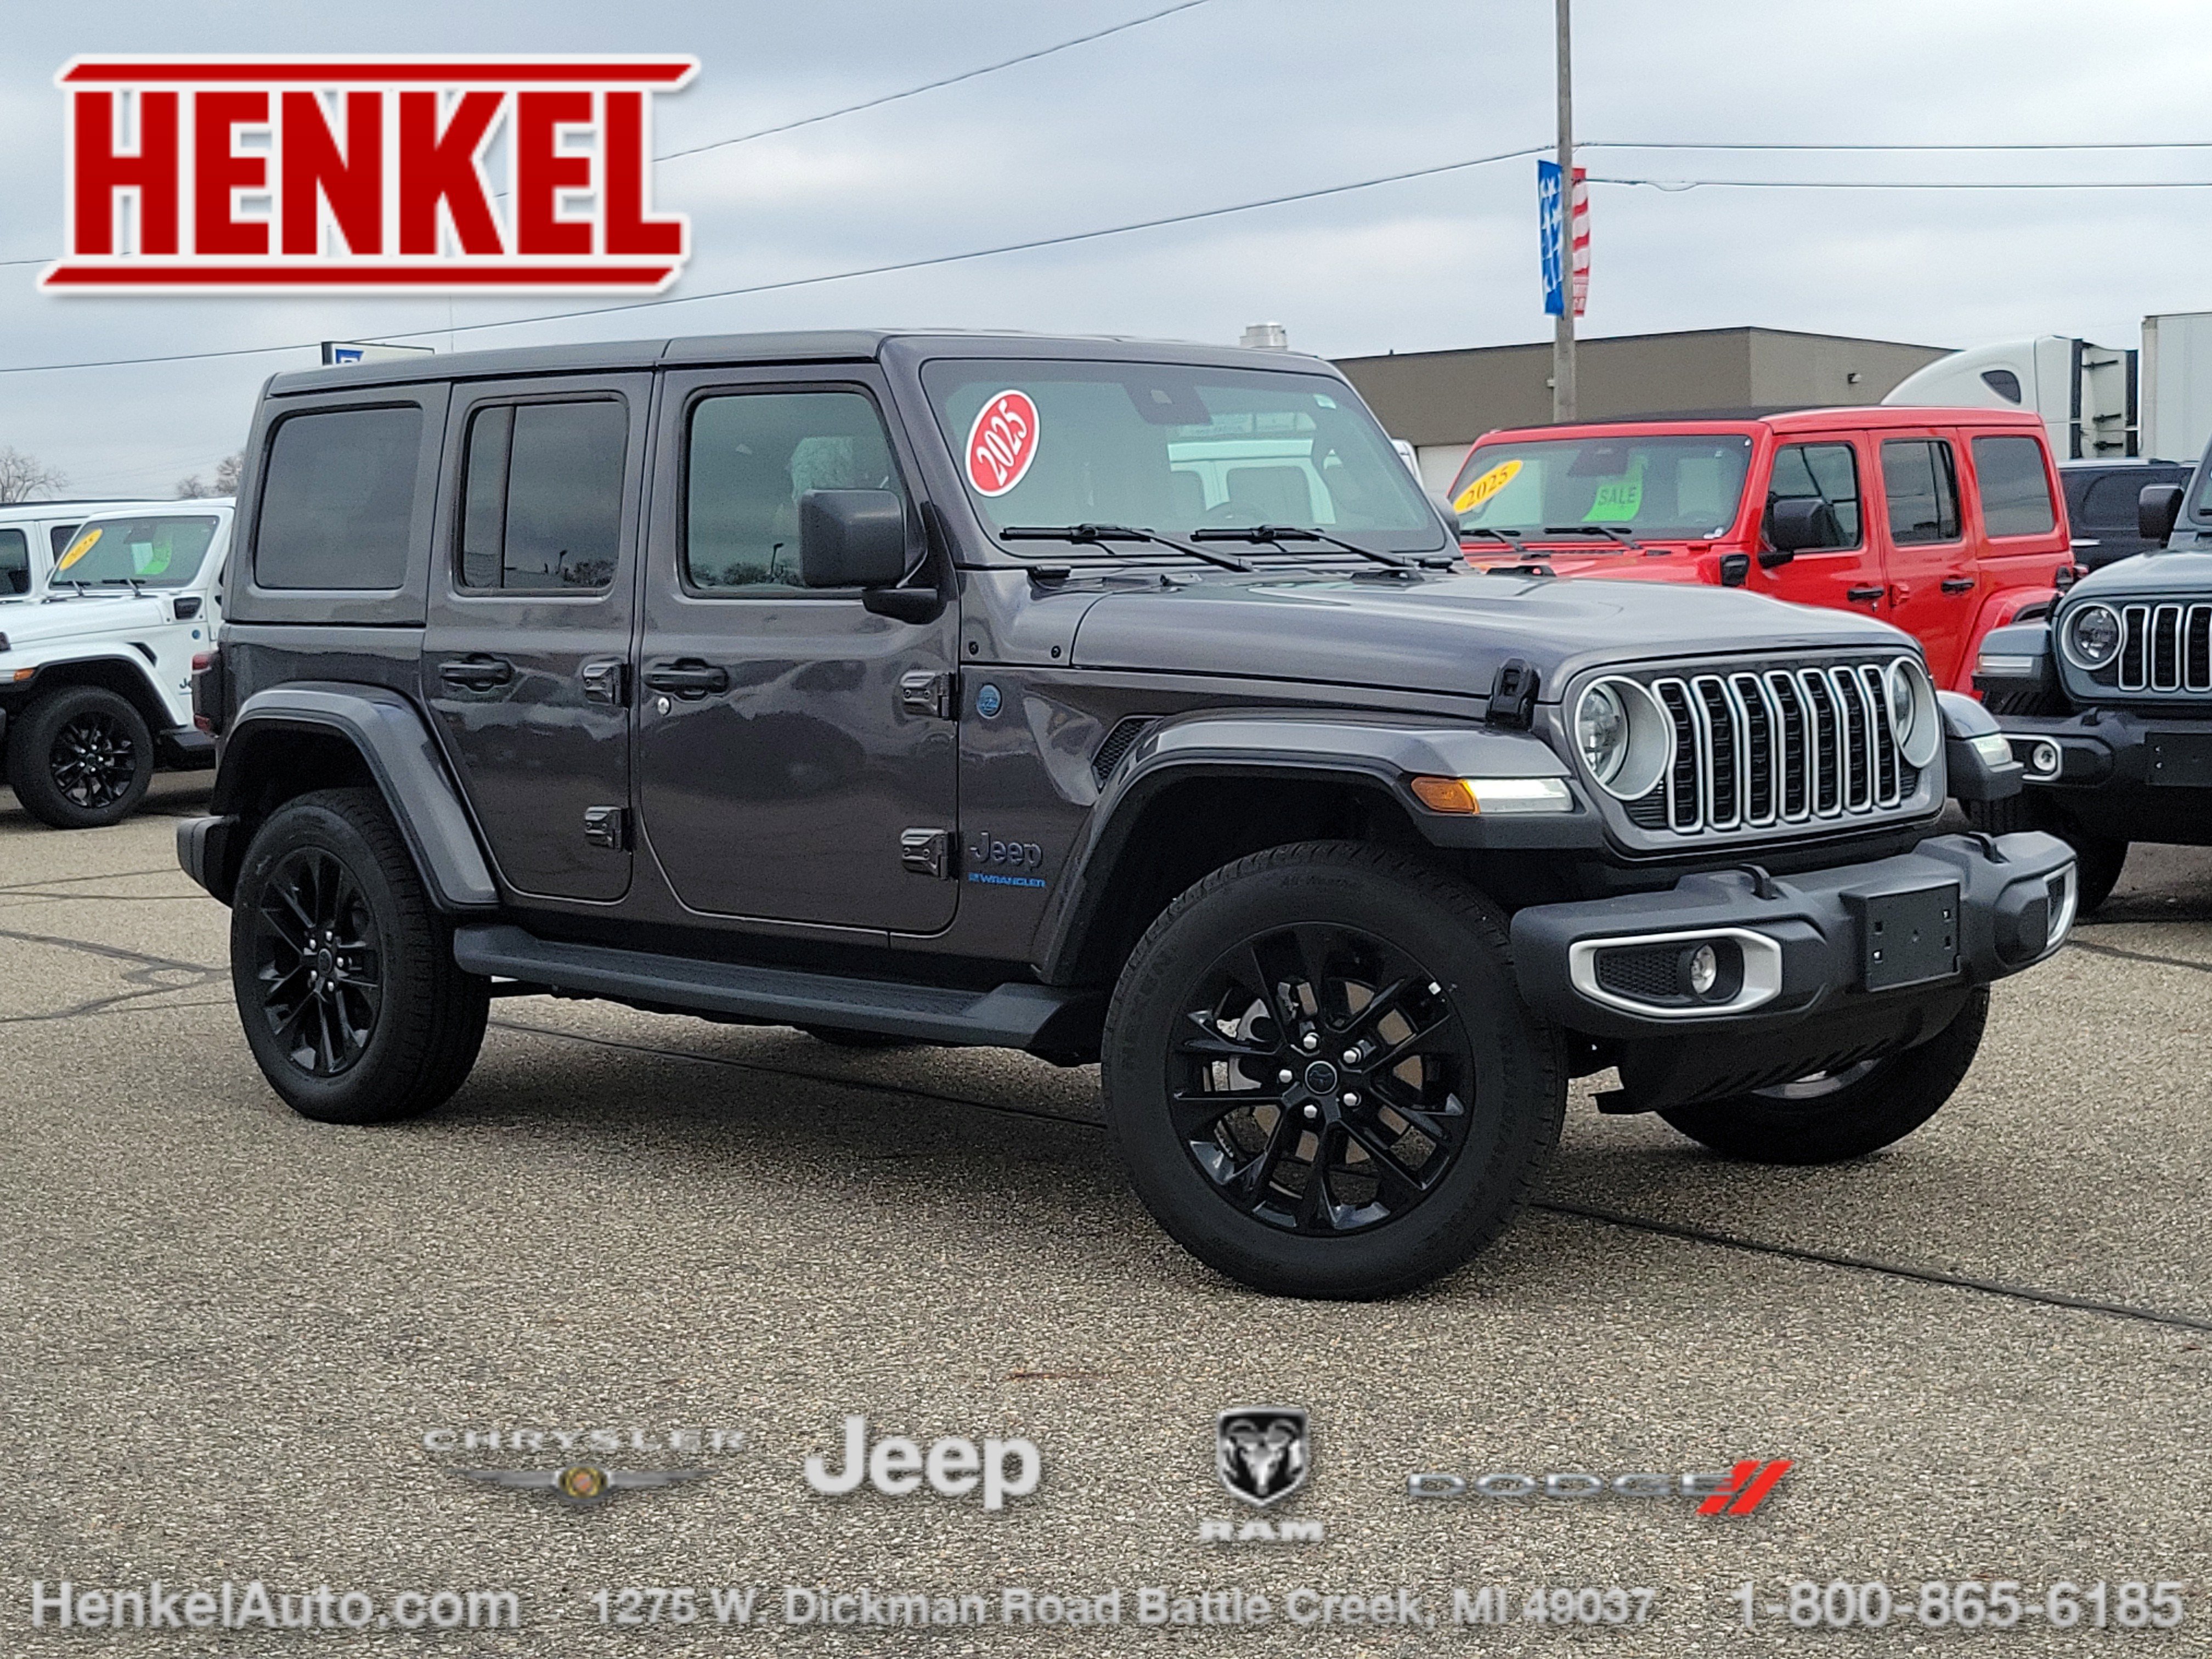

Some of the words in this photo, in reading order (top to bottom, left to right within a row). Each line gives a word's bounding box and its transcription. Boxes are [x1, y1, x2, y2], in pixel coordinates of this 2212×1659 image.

[976, 399, 1027, 486] 2025
[1466, 466, 1509, 506] 2025
[1598, 484, 1637, 506] SALE
[969, 831, 1042, 872] Jeep
